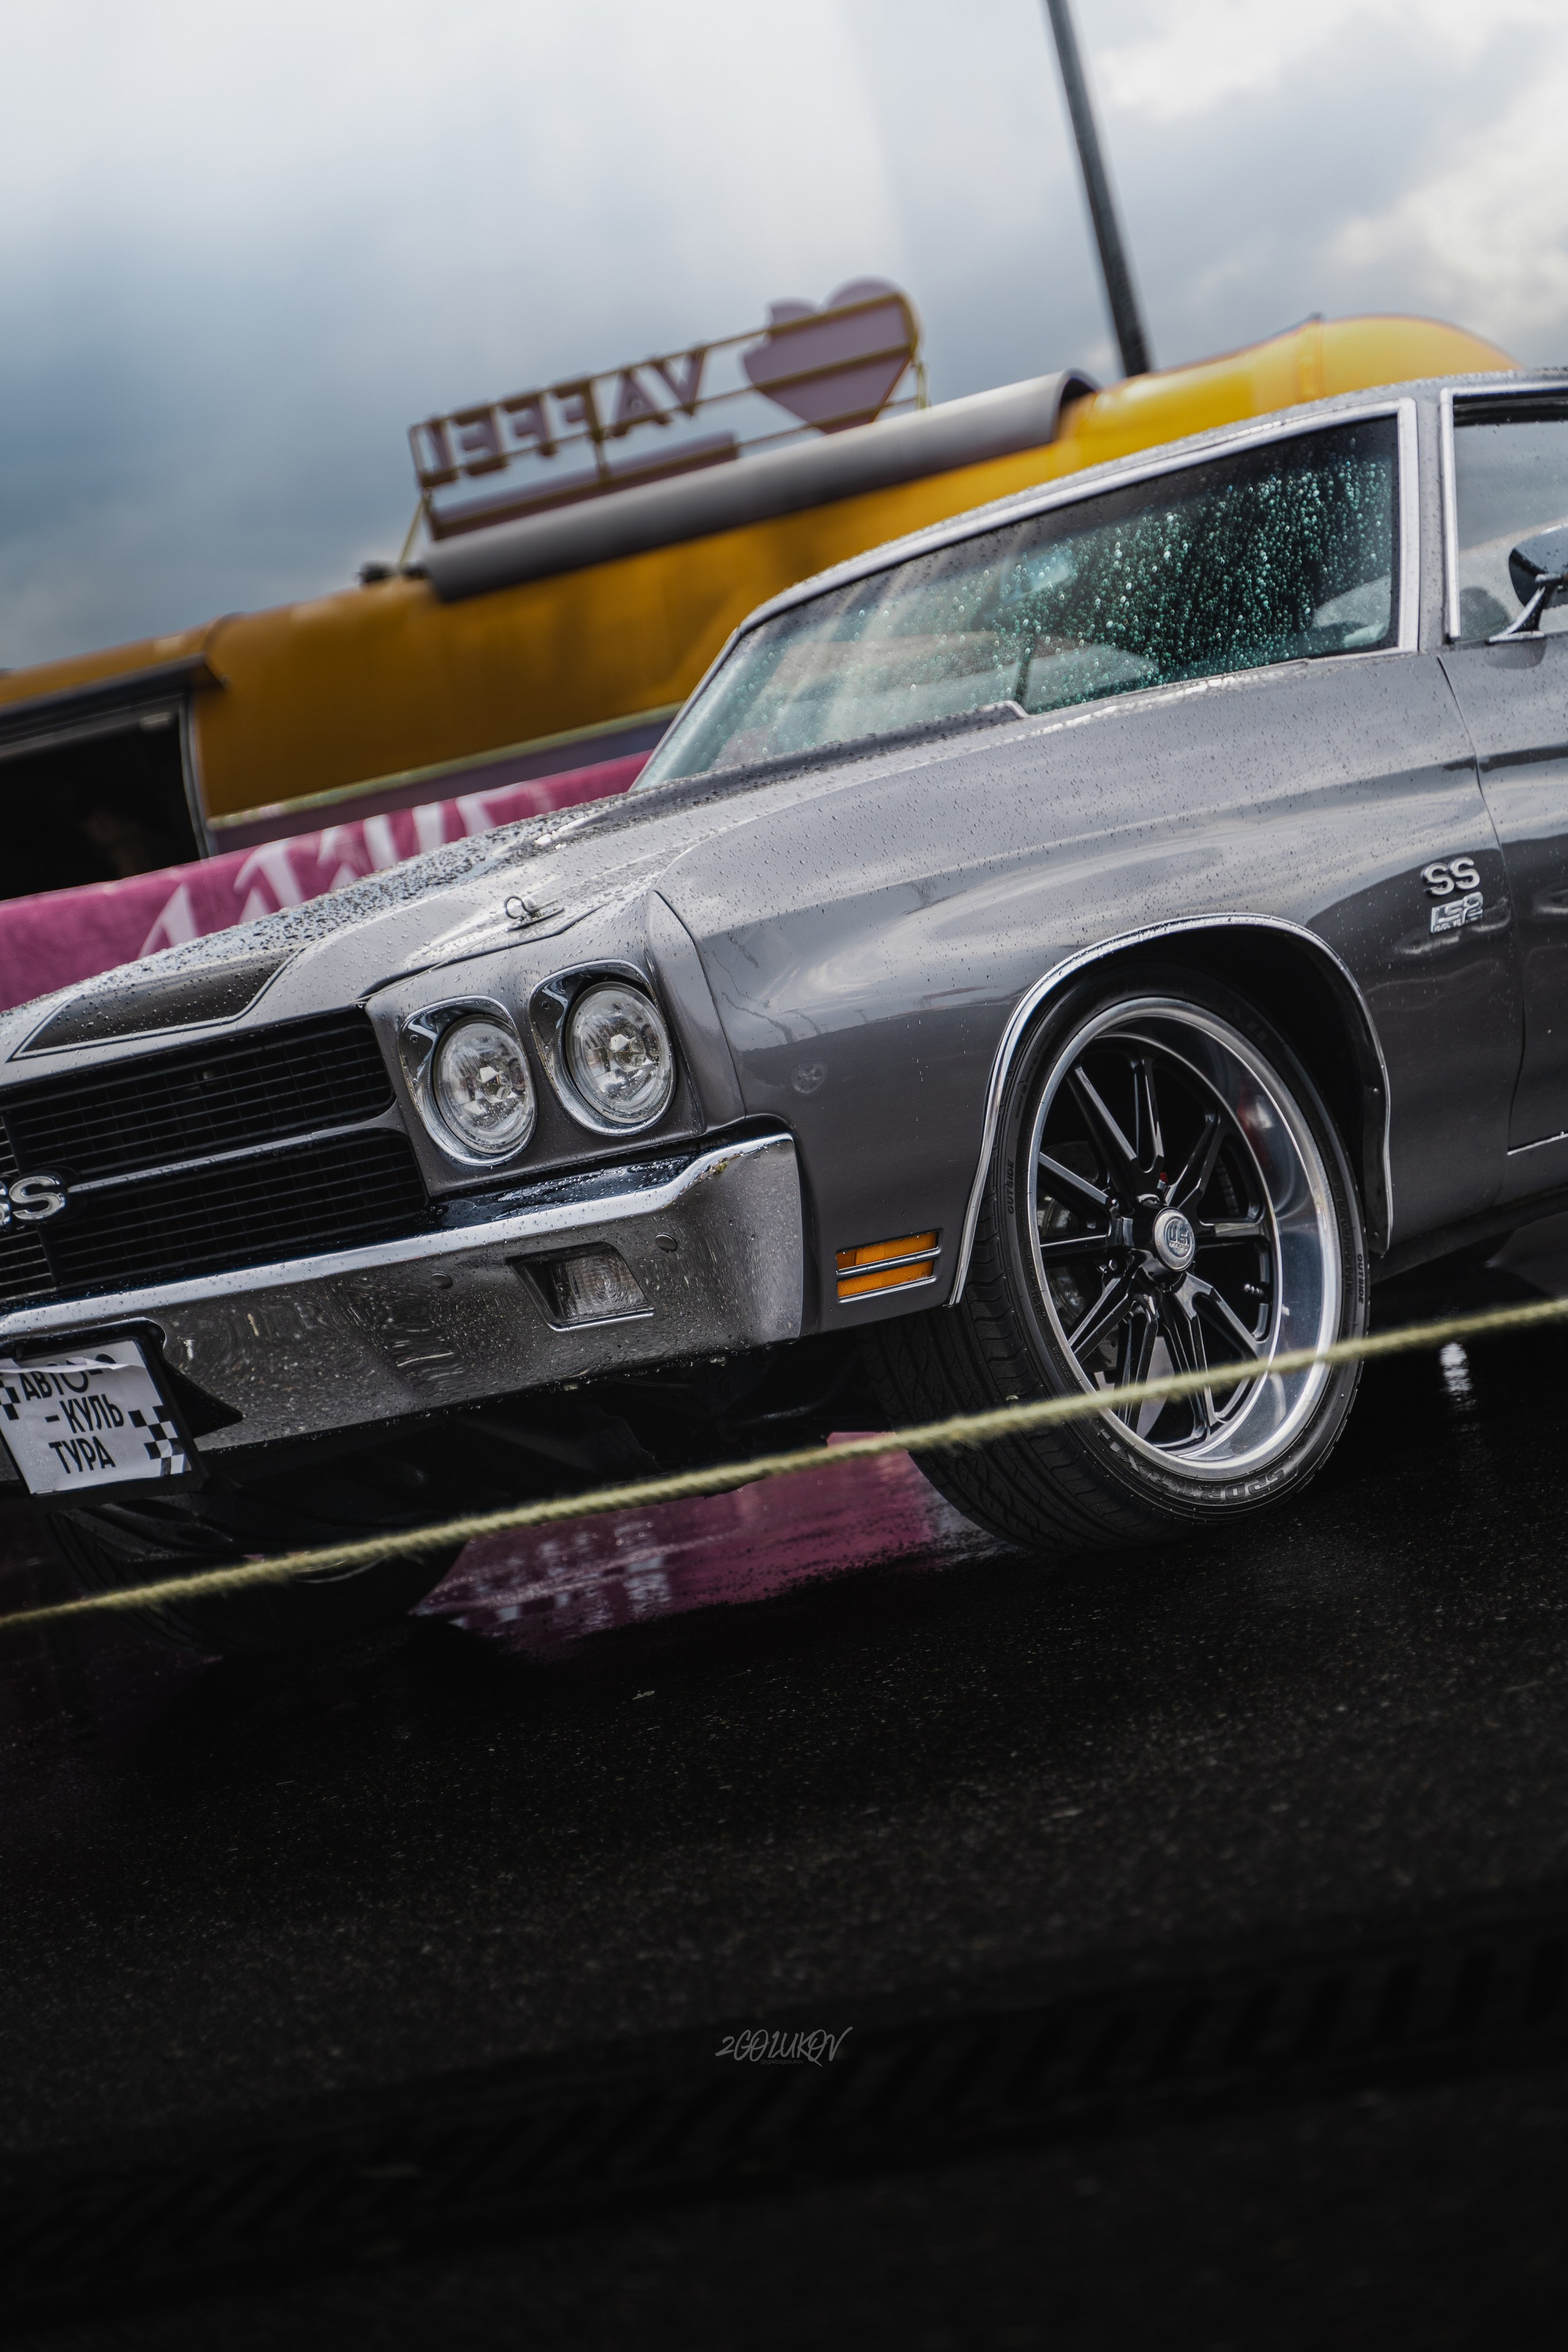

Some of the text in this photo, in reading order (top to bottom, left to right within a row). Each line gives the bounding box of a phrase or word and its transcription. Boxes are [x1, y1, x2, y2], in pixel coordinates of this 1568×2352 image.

[1420, 857, 1480, 895] SS
[0, 1175, 66, 1224] S
[48, 1436, 116, 1474] ТУРА
